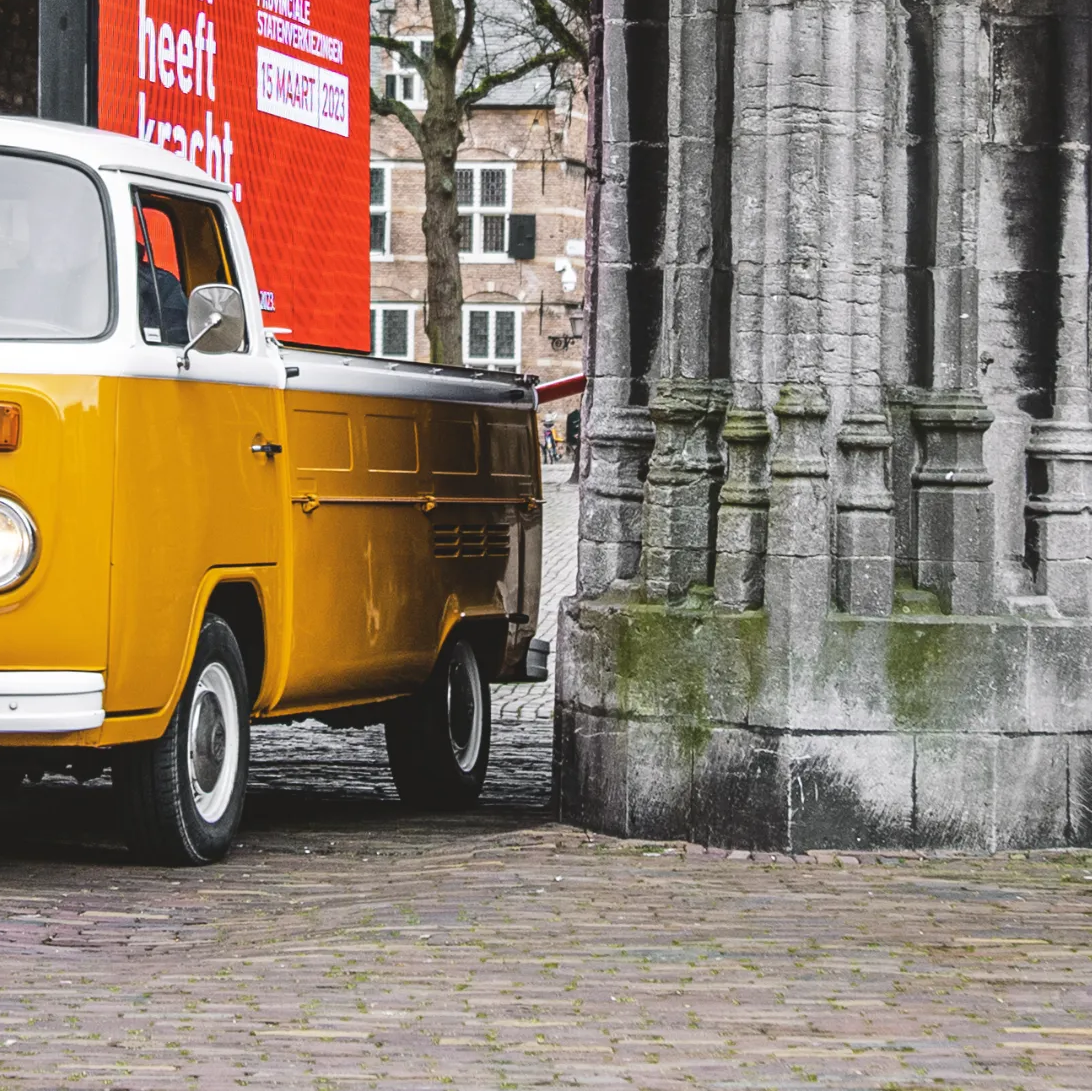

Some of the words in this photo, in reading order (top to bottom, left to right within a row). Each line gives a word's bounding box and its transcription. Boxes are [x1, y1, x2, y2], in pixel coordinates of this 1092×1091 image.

[256, 9, 344, 65] STATENVERKIEZINGEN
[261, 61, 273, 100] 15
[276, 66, 316, 113] MAART
[321, 82, 346, 123] 2023
